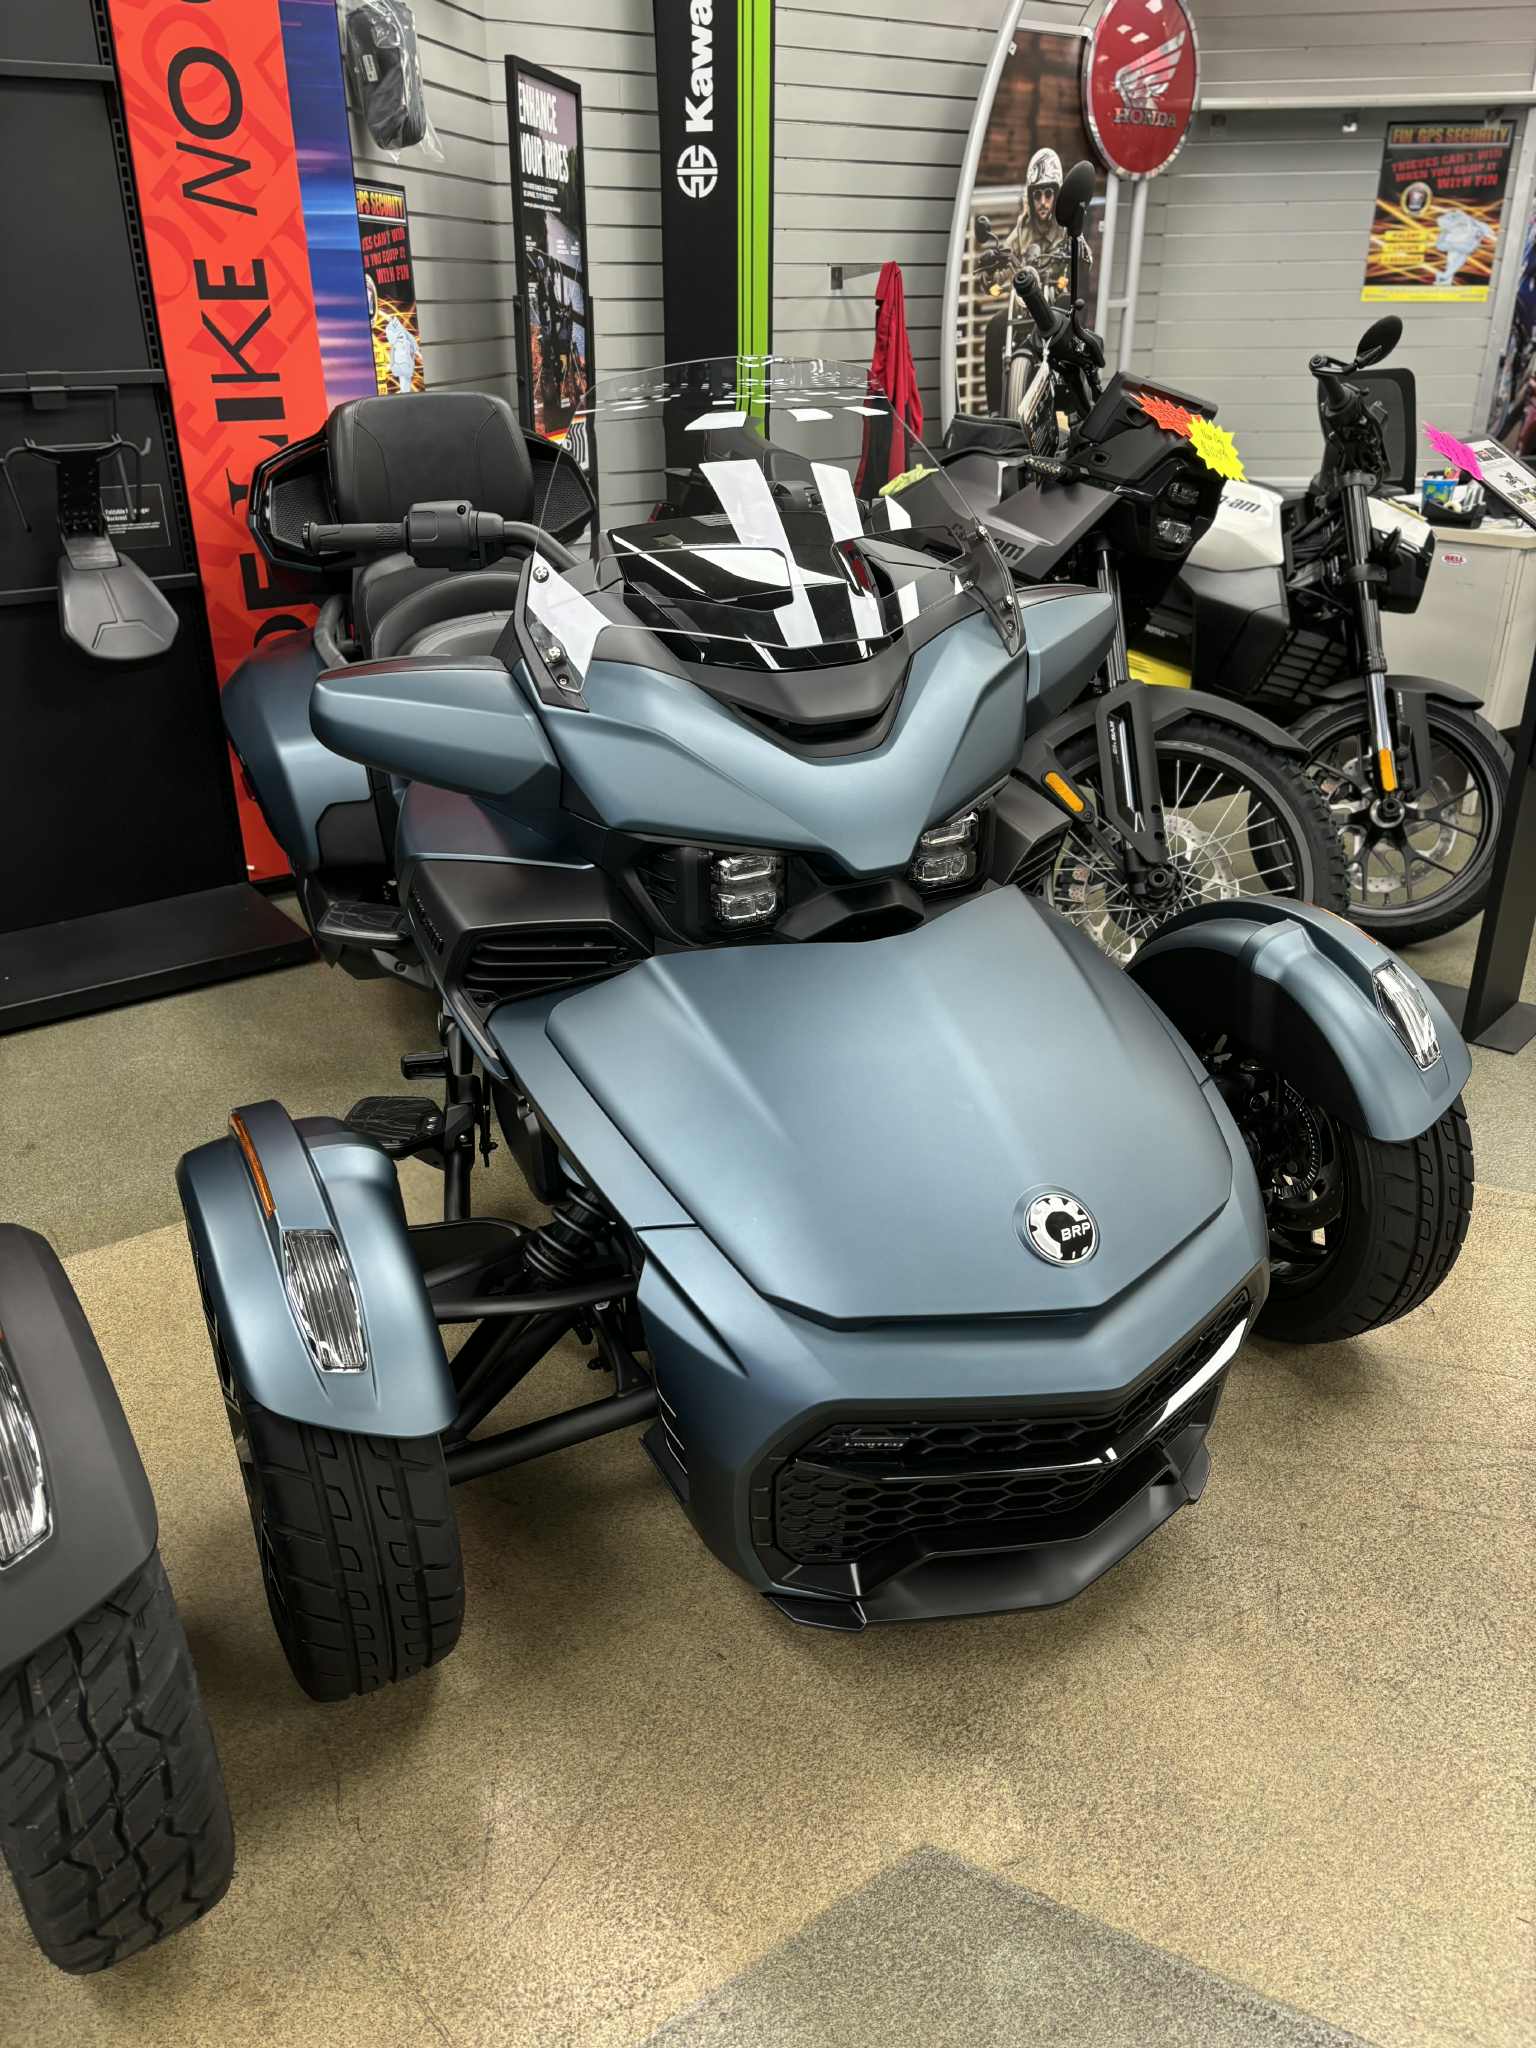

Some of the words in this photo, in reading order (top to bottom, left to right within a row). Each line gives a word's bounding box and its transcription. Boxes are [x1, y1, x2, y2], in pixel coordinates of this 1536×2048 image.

[685, 0, 713, 132] Kawa
[518, 81, 557, 134] ENHANCE
[1113, 107, 1176, 128] HONDA
[167, 46, 258, 216] NO
[1417, 127, 1444, 144] GPS
[1445, 126, 1509, 144] SECURITY
[520, 131, 543, 178] YOUR
[544, 139, 569, 183] RIDES
[1475, 174, 1499, 187] FIN
[1061, 1221, 1091, 1241] BRP
